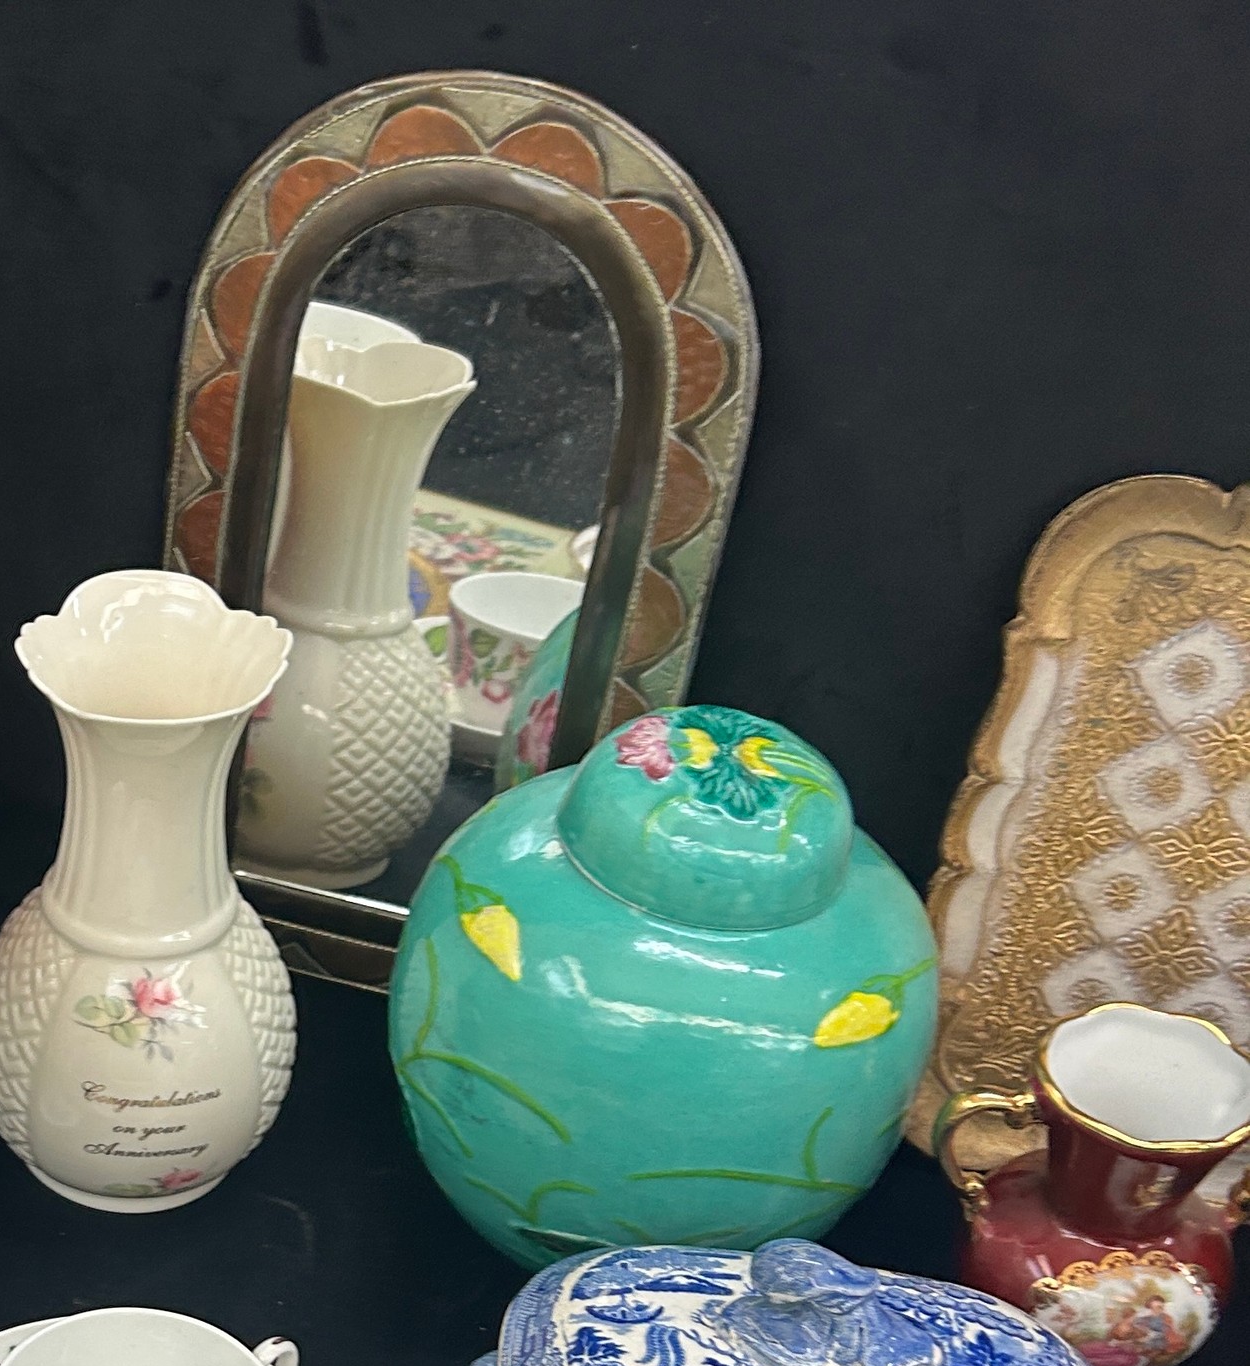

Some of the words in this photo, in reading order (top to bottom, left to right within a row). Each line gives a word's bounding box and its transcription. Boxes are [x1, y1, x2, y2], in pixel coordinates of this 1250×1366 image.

[80, 1080, 221, 1112] Congratulations
[112, 1125, 137, 1133] on
[138, 1124, 187, 1141] your
[83, 1143, 209, 1158] Anniversary
